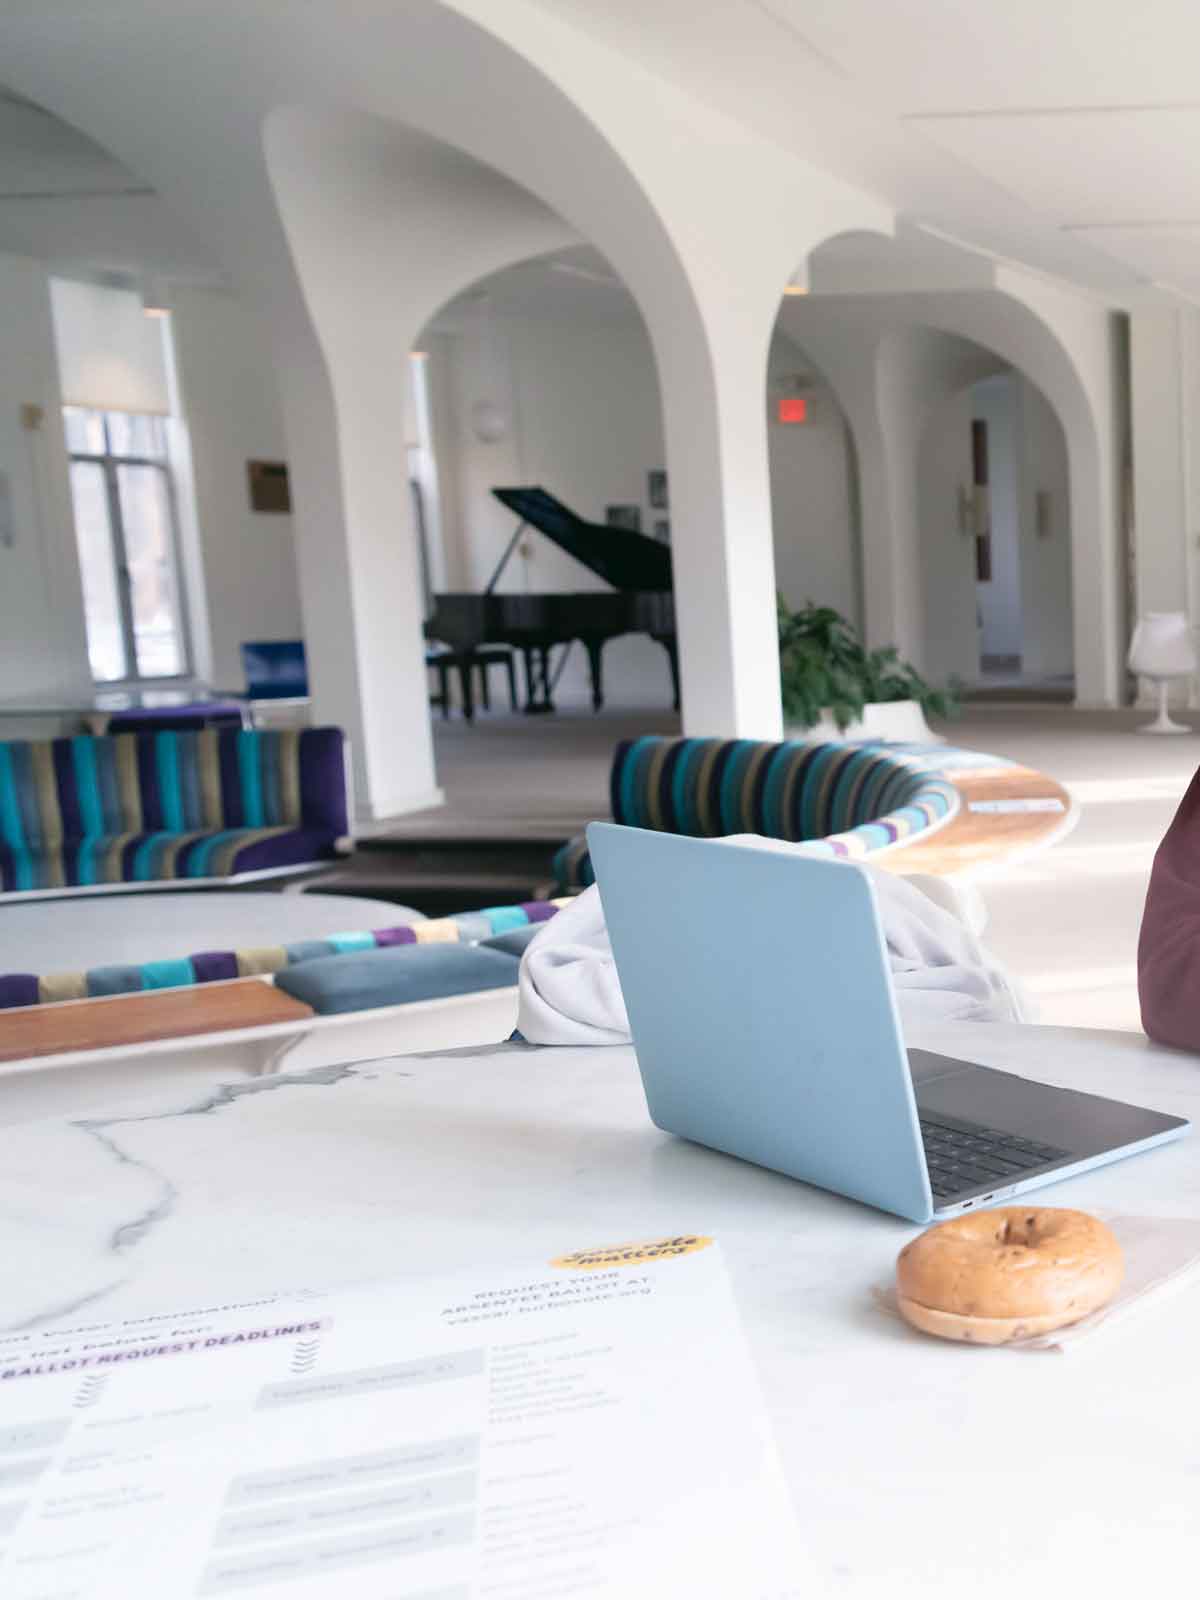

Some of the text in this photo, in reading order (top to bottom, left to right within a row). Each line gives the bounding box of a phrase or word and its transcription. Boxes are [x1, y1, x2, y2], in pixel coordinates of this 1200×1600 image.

[1, 1320, 321, 1380] BALLOT REQUEST DEADLINES
